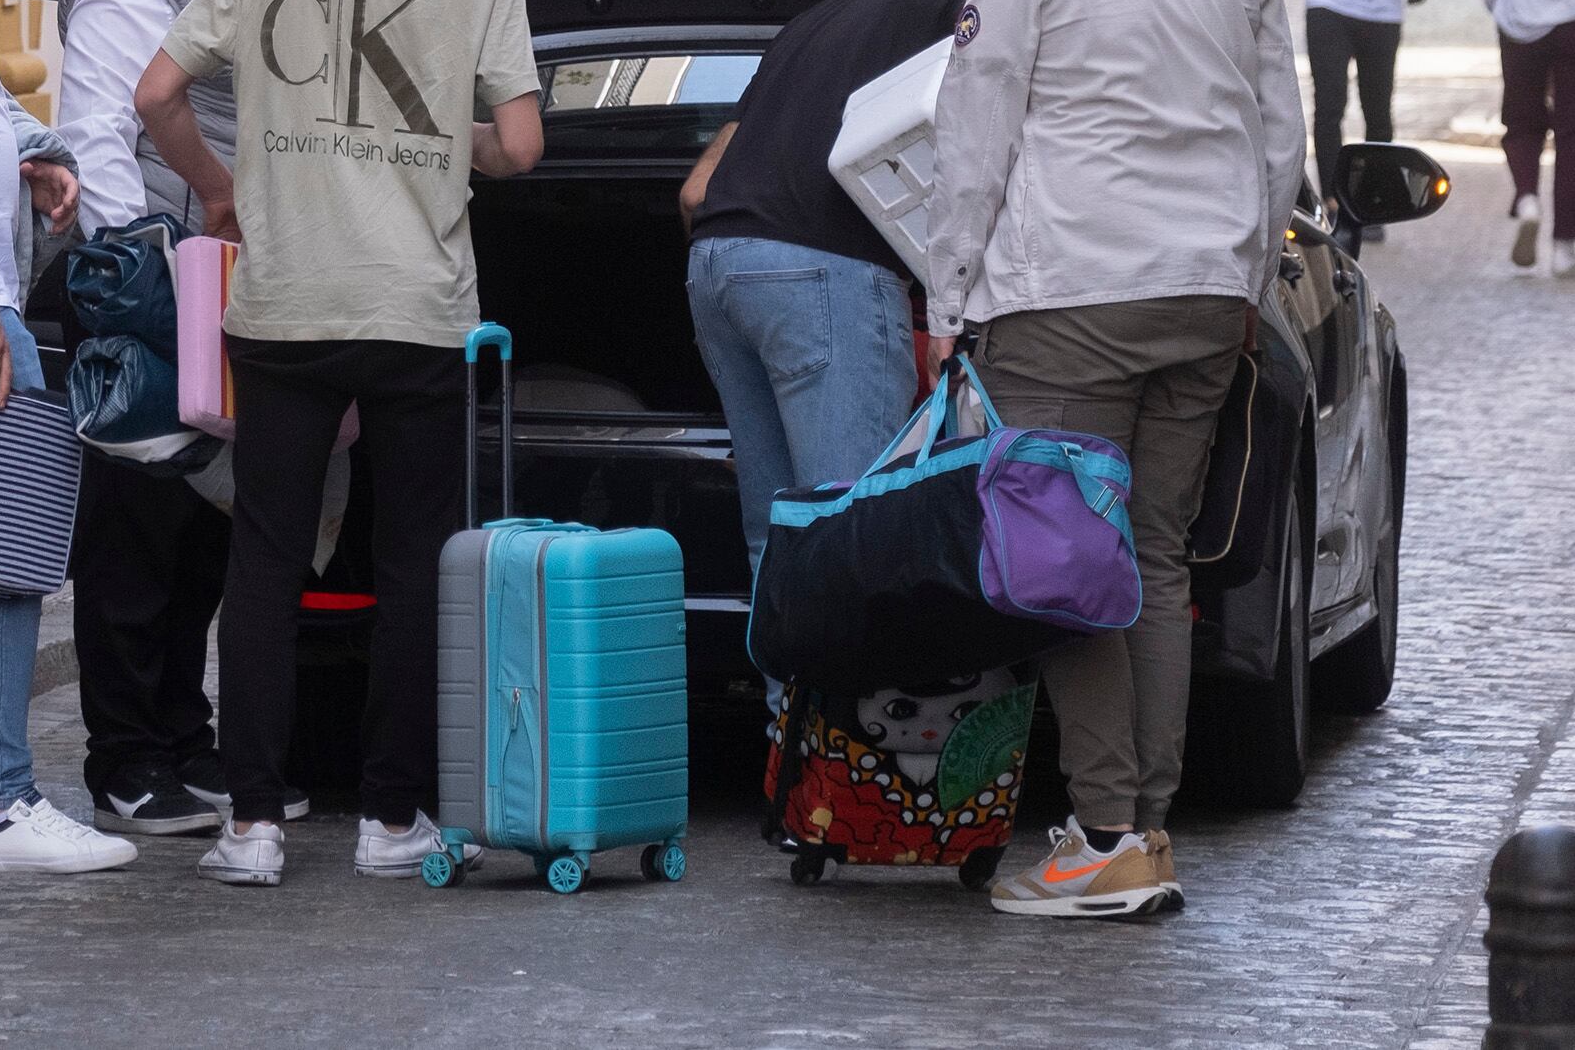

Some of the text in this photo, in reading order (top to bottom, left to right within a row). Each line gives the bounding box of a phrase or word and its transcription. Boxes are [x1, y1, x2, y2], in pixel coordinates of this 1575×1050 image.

[264, 129, 451, 171] Calvin Klein Jeans
